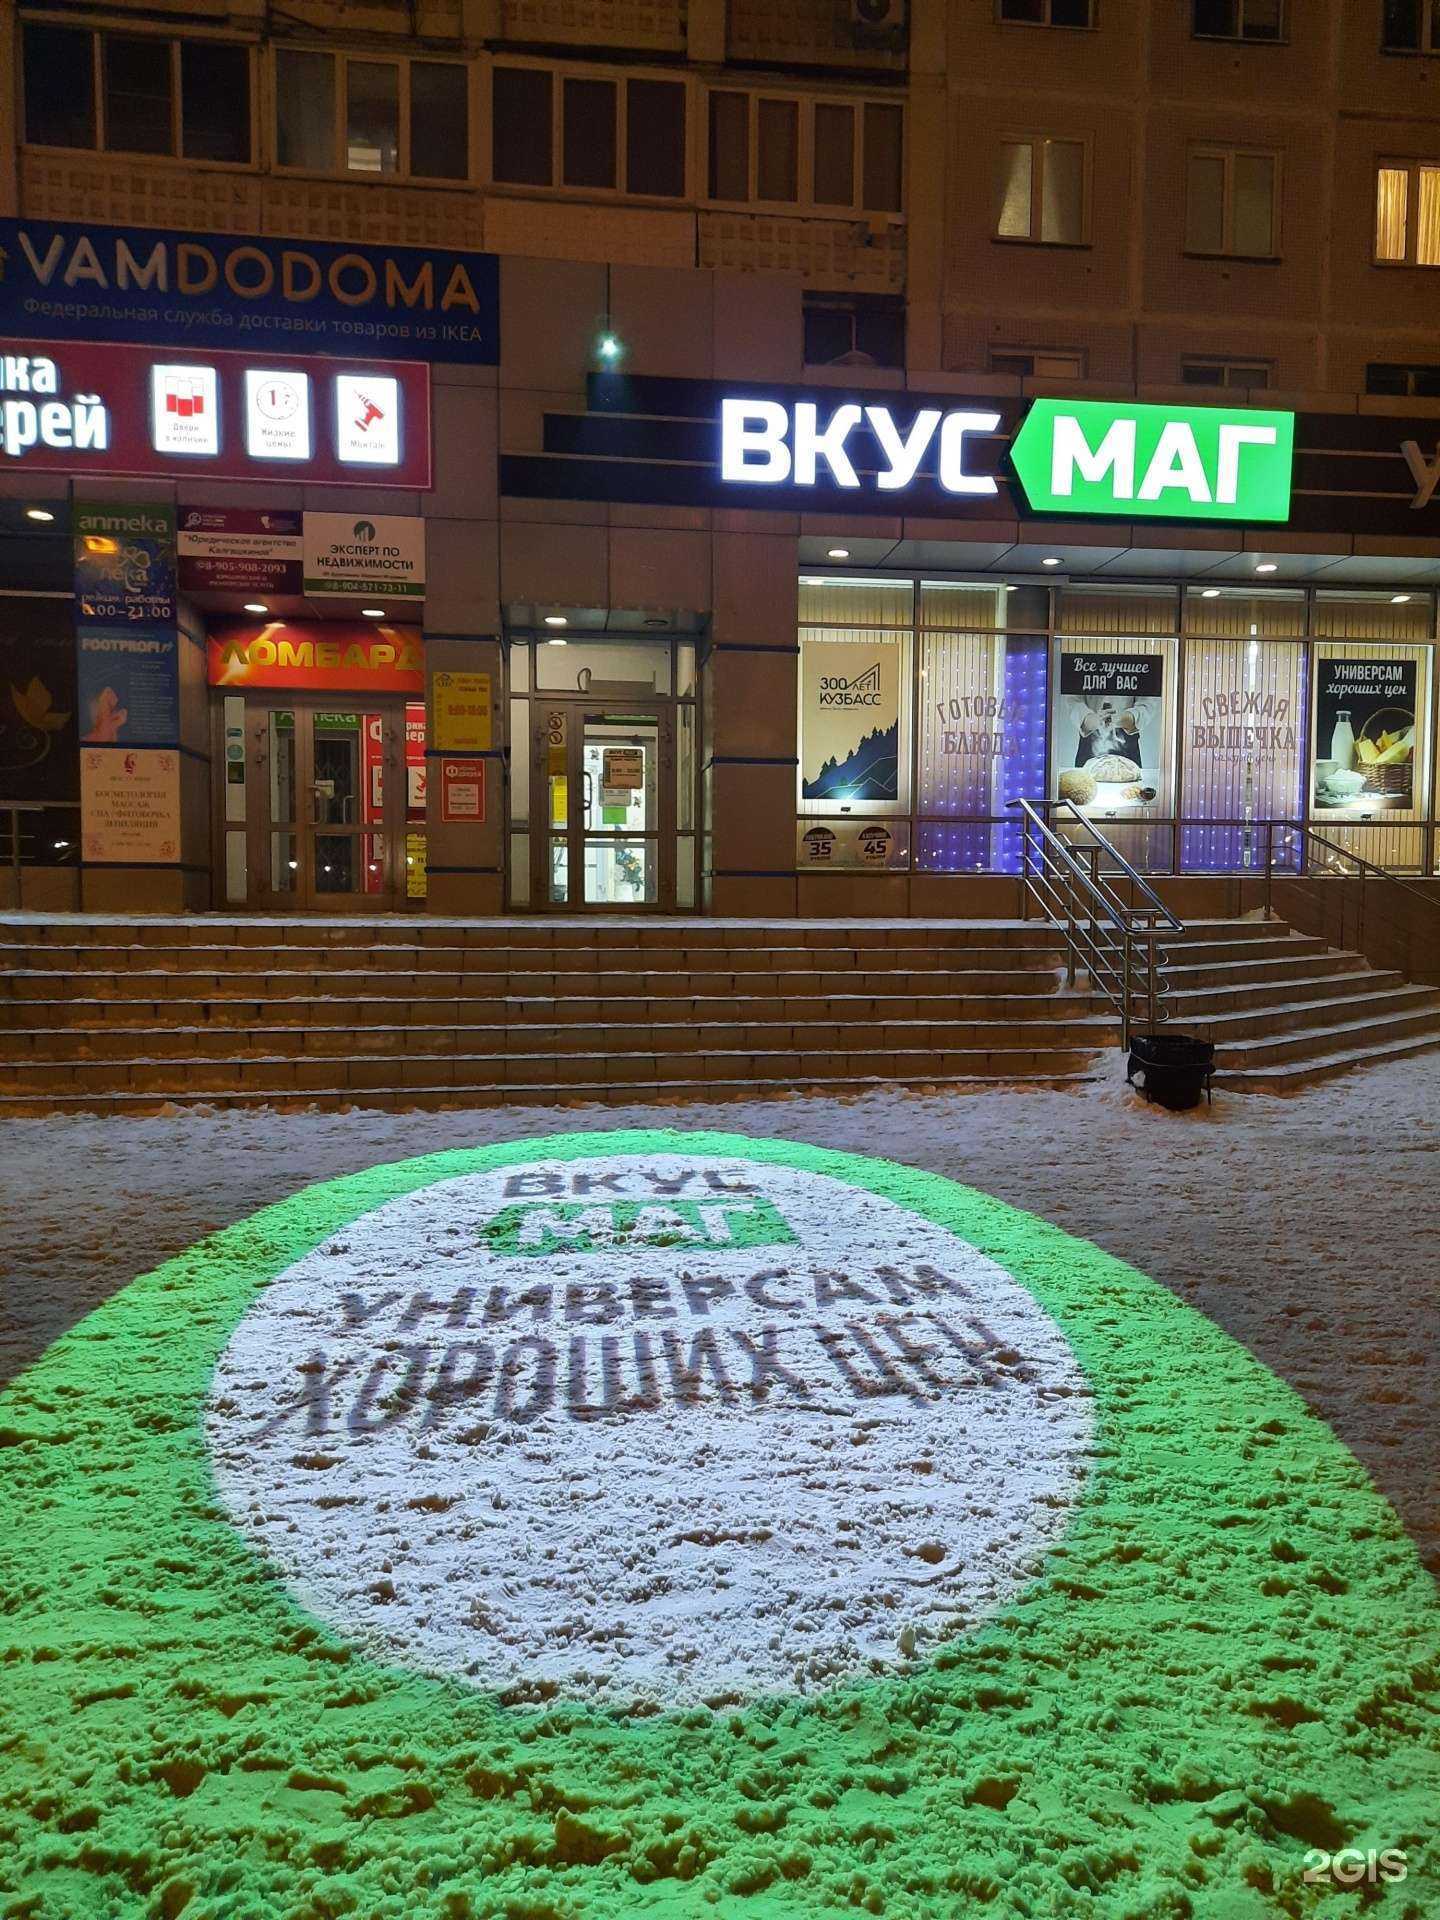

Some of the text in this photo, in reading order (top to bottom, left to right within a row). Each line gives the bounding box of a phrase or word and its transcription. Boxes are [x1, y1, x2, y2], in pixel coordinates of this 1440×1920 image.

[18, 231, 482, 315] VAMDODOMA
[23, 296, 483, 343] Федеральная служба доставки товаров из IKEA
[0, 355, 59, 394] ка
[0, 393, 108, 457] рей
[722, 399, 1277, 507] ВКУС МАГ
[317, 556, 415, 570] НЕДВИЖИМОСТИ
[330, 544, 401, 557] ЭКСПЕРТ ПО
[222, 638, 422, 671] ЛОМБАРД
[1073, 656, 1149, 679] Все лучшее
[820, 677, 848, 691] 300
[1082, 674, 1138, 690] ДЛЯ ВАС
[1334, 664, 1403, 681] УНИВЕРСАМ
[819, 693, 882, 706] КУЗБАСС
[1326, 682, 1407, 699] хороших цен
[1202, 691, 1290, 722] СВЕЖАЯ
[943, 731, 1020, 755] БЛЮДА
[1192, 725, 1296, 751] ВЫПЕЧКА
[809, 842, 833, 856] 35
[863, 840, 887, 854] 45
[503, 1170, 760, 1198] ВКУС
[518, 1203, 754, 1248] МАГ
[338, 1264, 974, 1331] УНИВЕРСАМ
[262, 1325, 812, 1440] ХОРОШИХ
